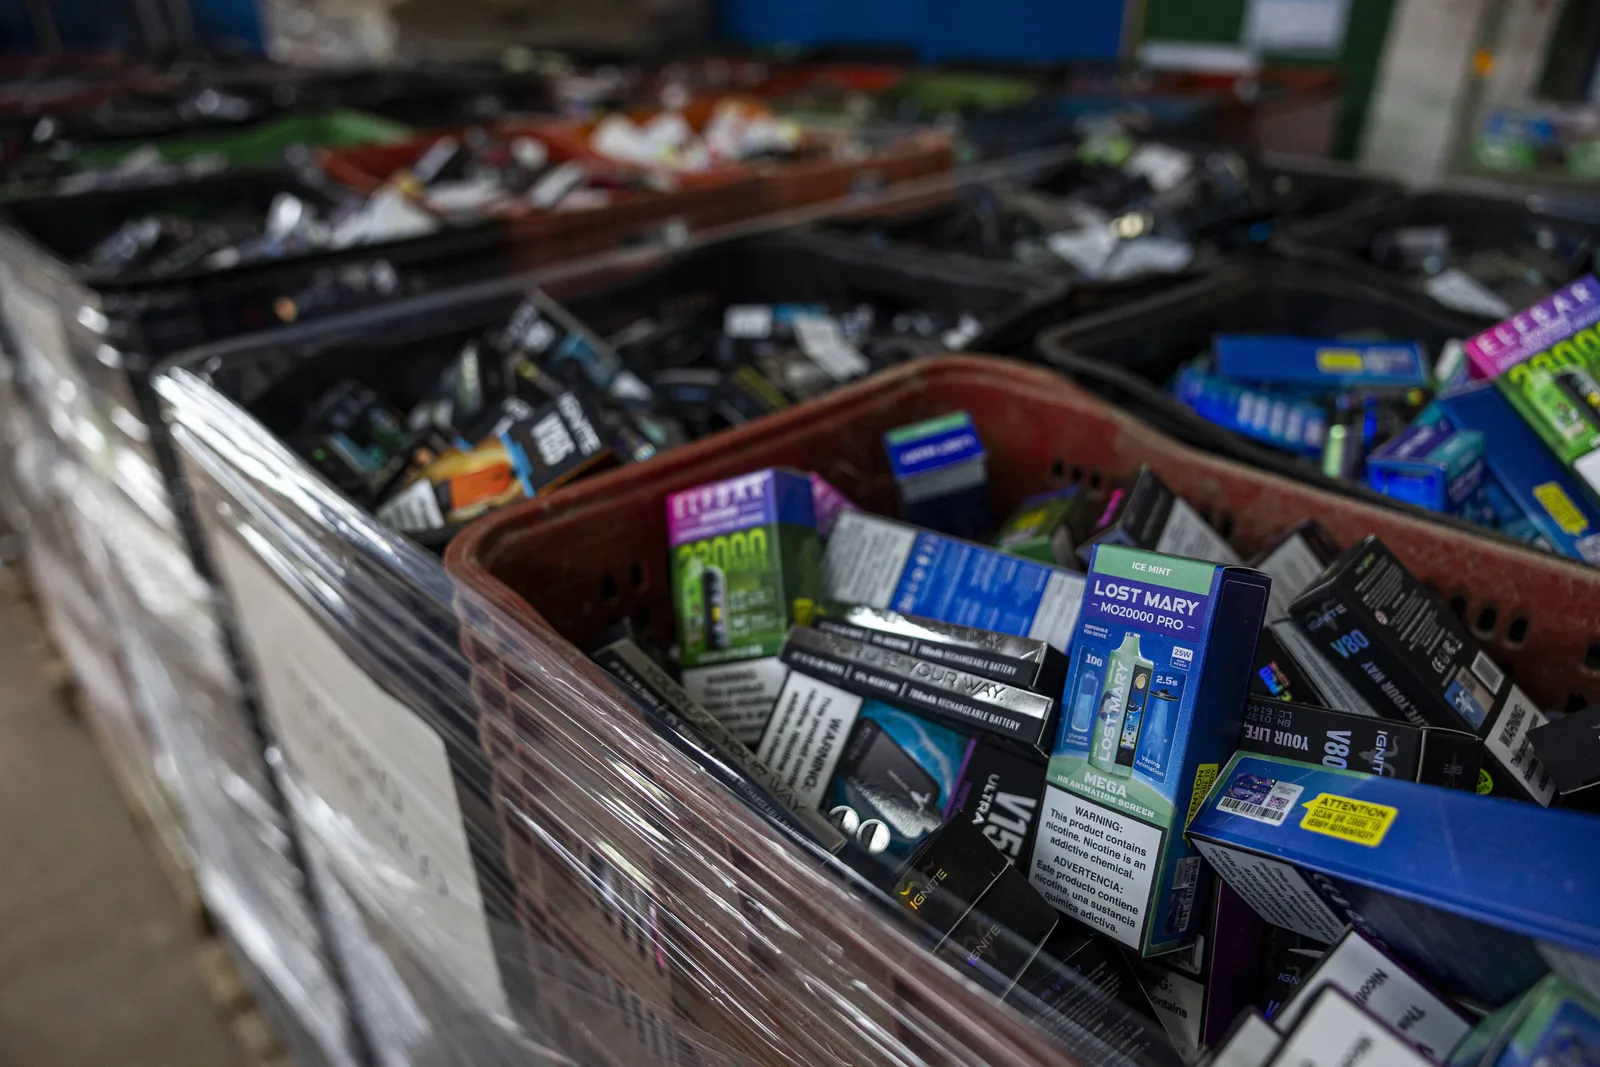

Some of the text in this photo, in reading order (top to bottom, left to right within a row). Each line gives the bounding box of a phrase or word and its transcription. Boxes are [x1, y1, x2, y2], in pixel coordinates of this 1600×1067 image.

[1132, 561, 1172, 577] ICE MINT
[1094, 580, 1200, 616] LOST MARY
[1101, 602, 1184, 631] MO20000 PRO
[1174, 649, 1191, 658] 25W
[1329, 629, 1370, 659] V80
[988, 662, 1018, 676] BATTERY
[1085, 653, 1103, 667] 100
[1361, 661, 1386, 684] WAY
[963, 676, 1006, 701] WAY.
[1156, 675, 1178, 686] 2.5s
[1381, 681, 1410, 710] YOUR
[937, 697, 990, 721] RECHARGEABLE
[988, 714, 1021, 732] BATTERY
[1098, 661, 1128, 761] LOST MARY
[1244, 722, 1309, 750] YOUR LIFE,
[1322, 730, 1352, 769] V80
[801, 718, 842, 792] WARNING:
[1141, 755, 1161, 769] Vaping
[1372, 730, 1388, 775] IGNIT
[1135, 760, 1164, 777] Animation
[972, 773, 1001, 825] ULTRA
[1068, 779, 1117, 804] ANIMATION
[1117, 798, 1156, 819] SCREEN
[1084, 771, 1127, 798] MEGA
[1074, 806, 1123, 833] WARNING:
[1311, 808, 1332, 819] SCAN
[1318, 797, 1389, 819] ATTENTION
[1045, 820, 1146, 871] nicotine. Nicotine is an
[1050, 808, 1147, 857] This product contains
[1050, 836, 1134, 880] addictive chemical.
[909, 868, 948, 910] IGNITE
[1036, 859, 1139, 915] Este producto contiene
[1053, 856, 1123, 894] ADVERTENCIA:
[1034, 872, 1136, 928] nicotina, una sustancia
[1044, 889, 1118, 933] química adictiva.
[966, 924, 1001, 966] IGNITE
[1277, 972, 1301, 985] IGN
